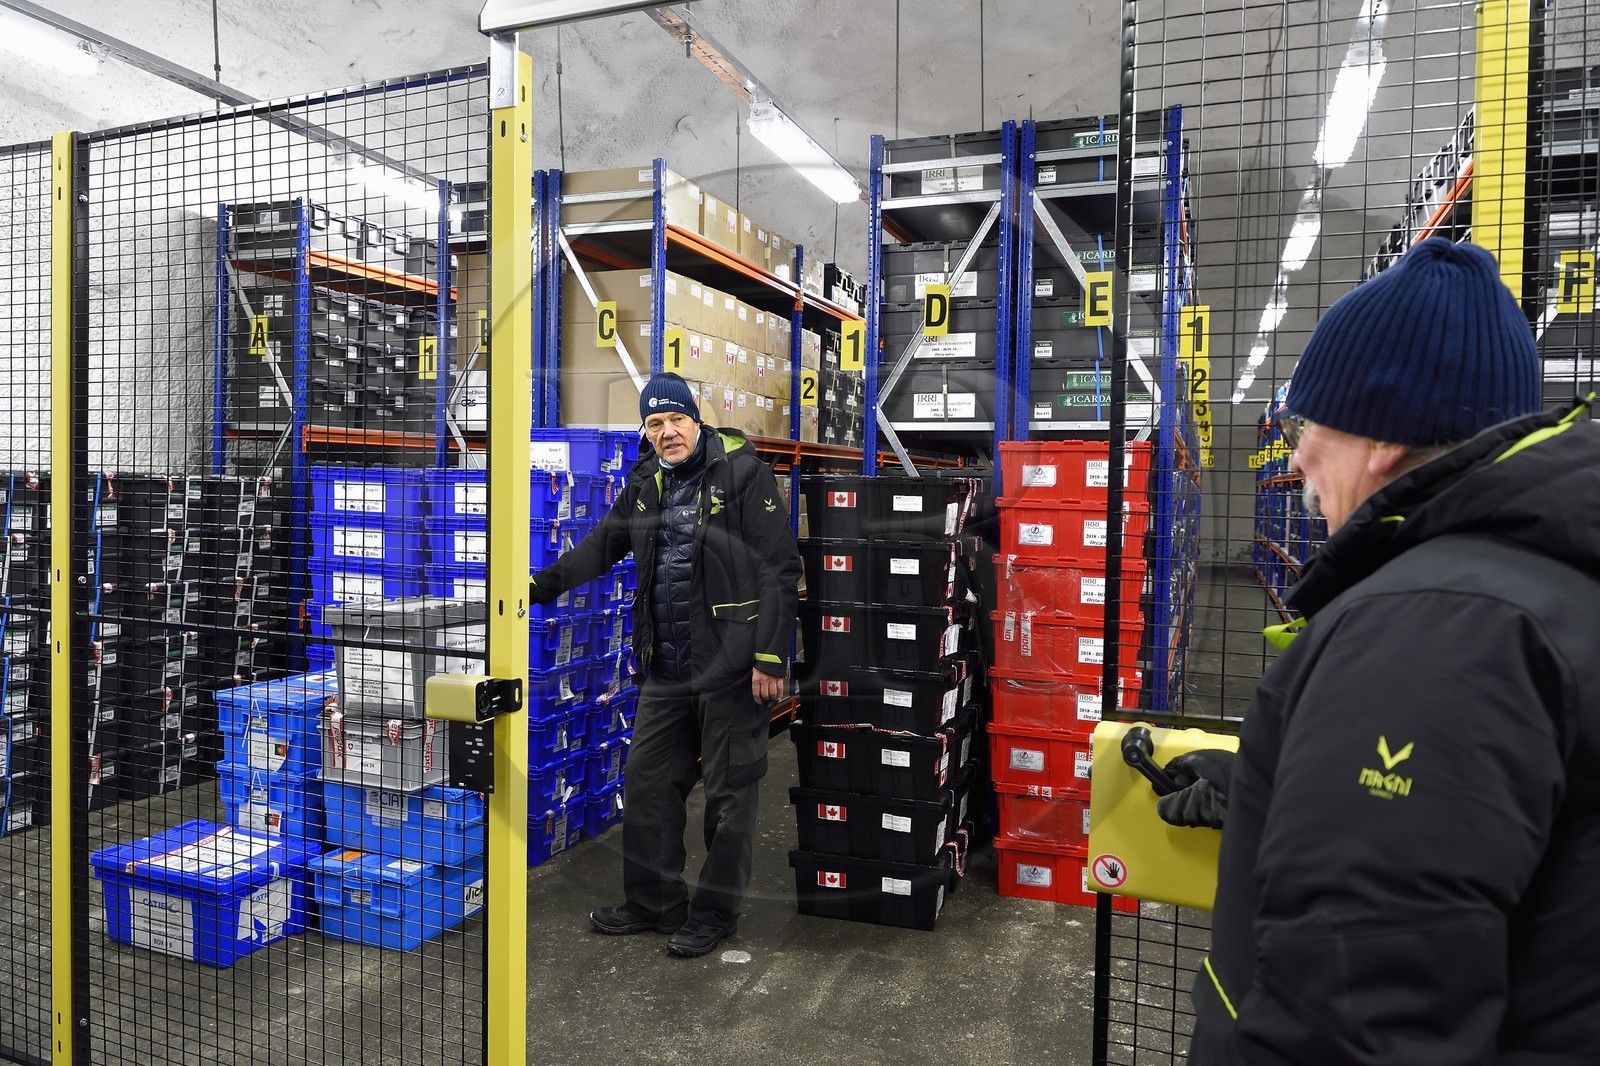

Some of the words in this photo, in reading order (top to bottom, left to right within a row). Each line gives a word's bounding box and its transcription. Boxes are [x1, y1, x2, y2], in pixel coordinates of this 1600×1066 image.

[1564, 262, 1590, 302] F
[926, 294, 947, 327] D
[1090, 281, 1108, 316] E
[252, 322, 266, 347] A
[599, 309, 614, 340] C
[1186, 316, 1203, 352] 1
[424, 344, 433, 372] 1
[668, 338, 680, 368] 1
[846, 330, 860, 362] 1
[803, 377, 815, 399] 2
[1192, 368, 1206, 394] 2
[1195, 400, 1207, 416] 3
[1260, 454, 1265, 462] 9
[380, 792, 405, 808] CIAT
